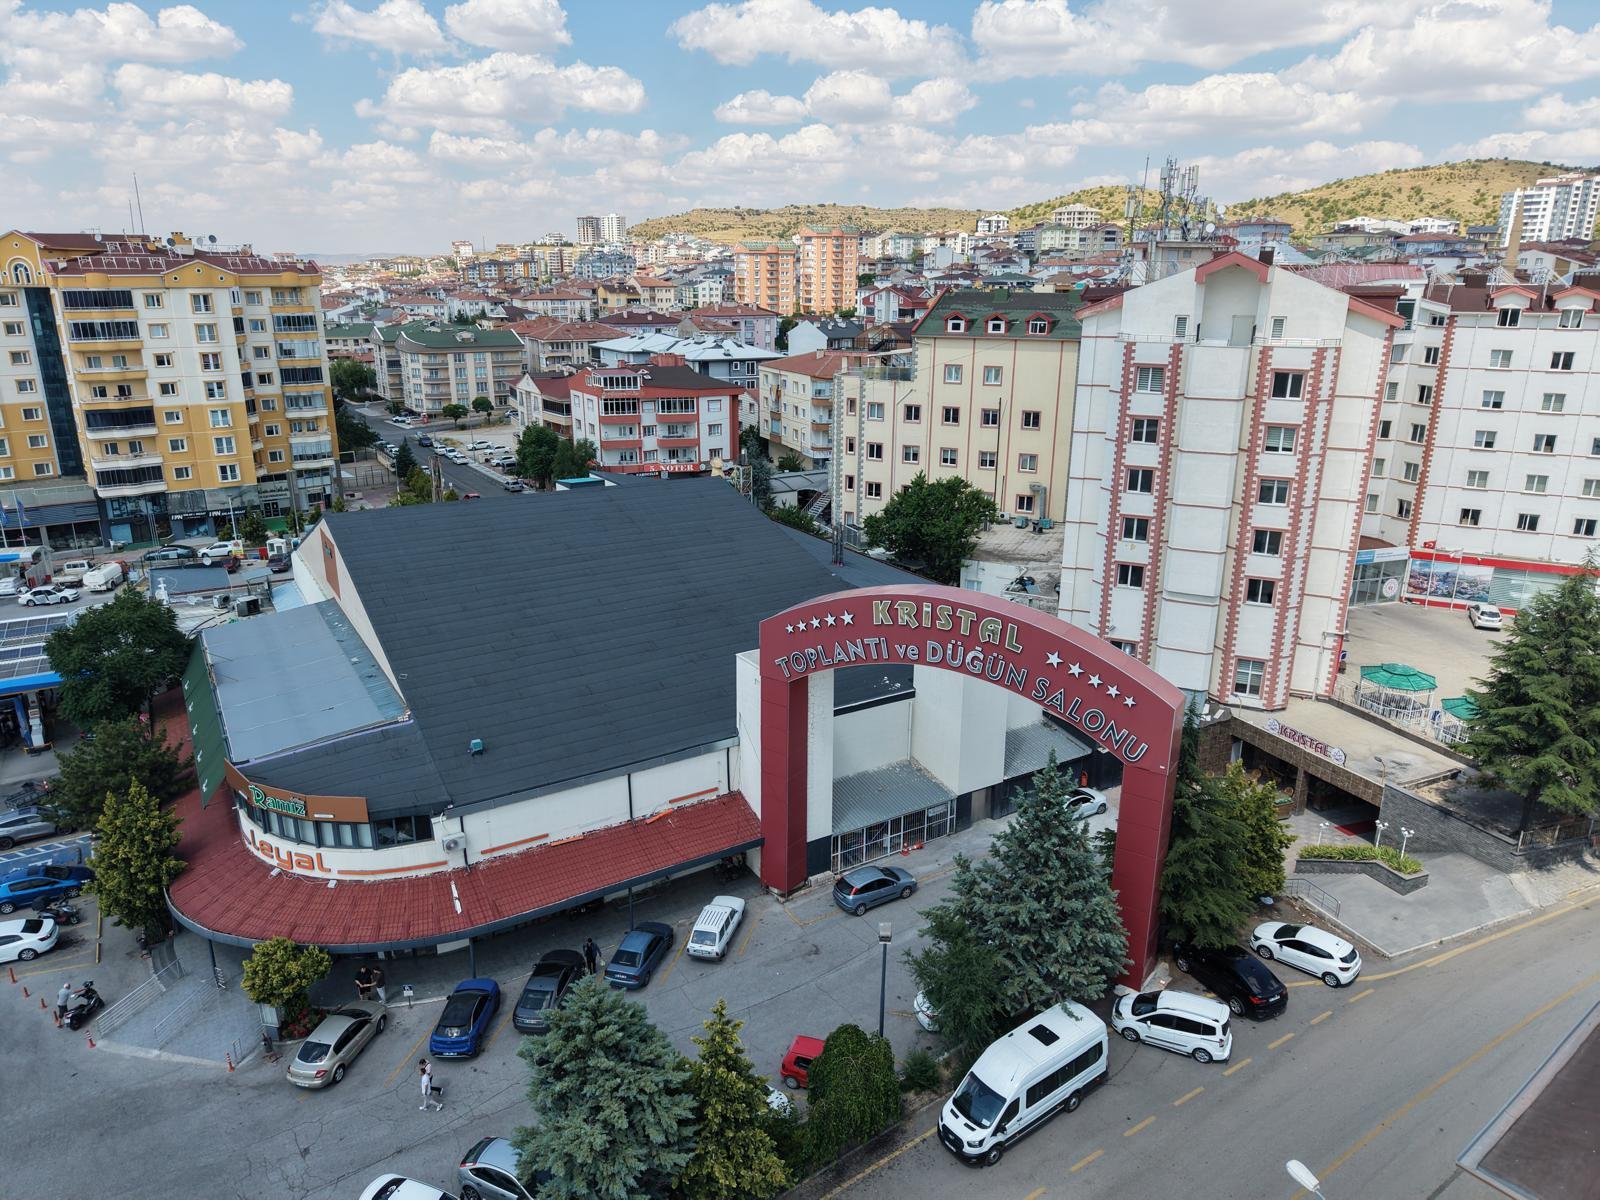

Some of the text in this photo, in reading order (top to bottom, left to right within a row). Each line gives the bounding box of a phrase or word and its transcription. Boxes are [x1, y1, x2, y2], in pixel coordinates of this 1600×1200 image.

[660, 463, 695, 472] NOTER
[774, 637, 1149, 764] TOPLANTI ve DÜĞÜN SALONU
